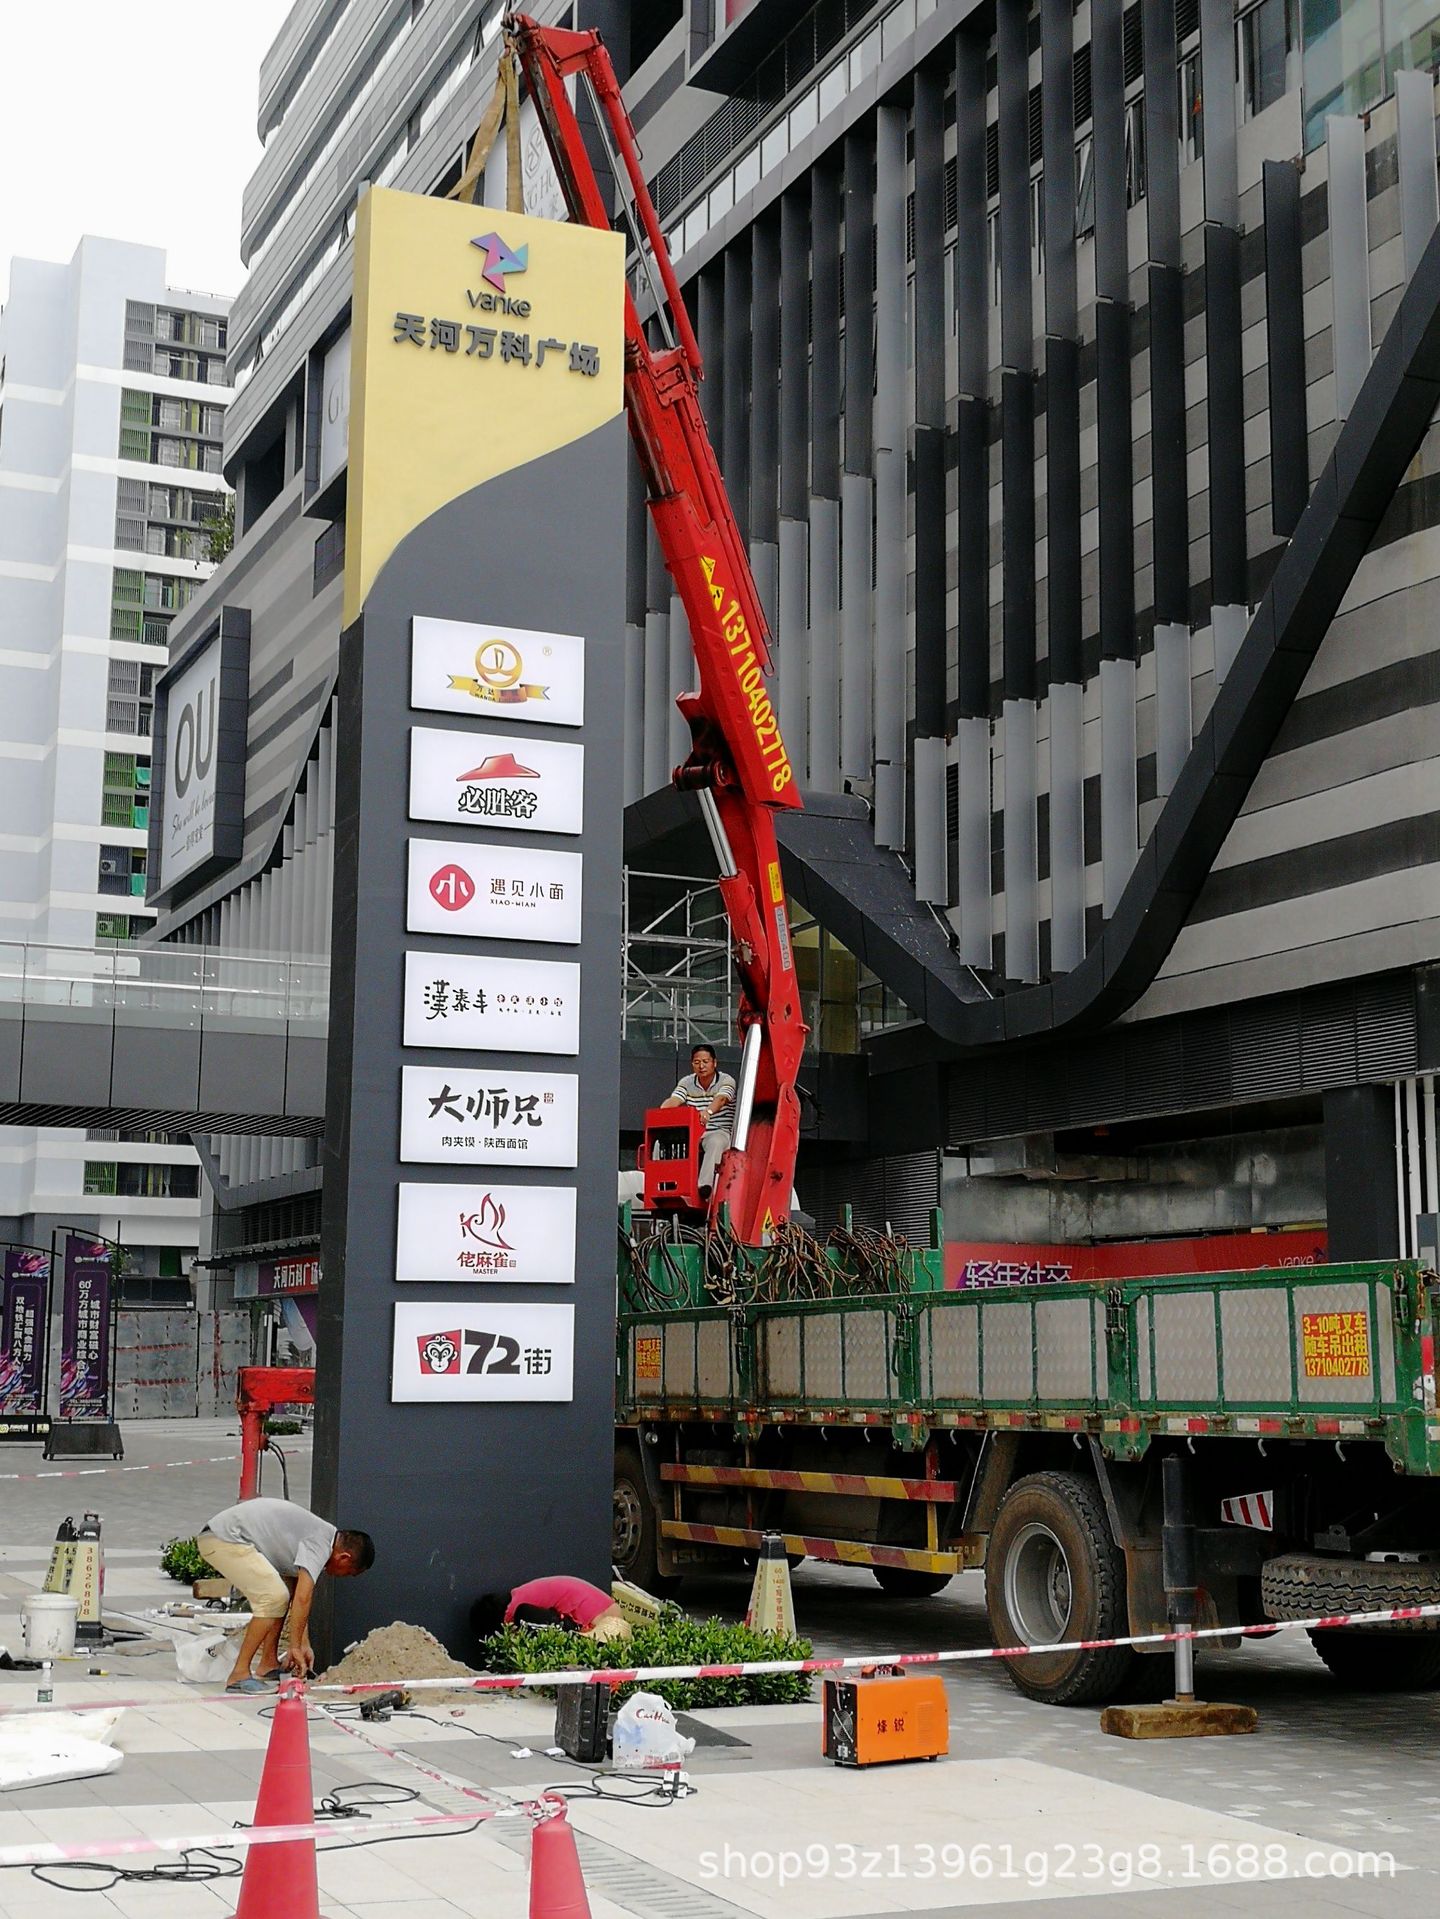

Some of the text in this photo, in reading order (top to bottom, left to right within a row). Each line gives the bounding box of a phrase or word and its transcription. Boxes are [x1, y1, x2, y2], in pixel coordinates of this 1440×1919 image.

[466, 289, 532, 318] vanke
[393, 312, 600, 377] 天河万科广场
[721, 600, 792, 793] 13710402778
[458, 785, 537, 818] 必胜客
[490, 878, 564, 900] 遇见小面
[428, 1084, 543, 1129] 大师兄
[456, 1251, 509, 1268] 佬麻雀
[1303, 1312, 1367, 1335] 3-10吨叉车
[464, 1329, 552, 1375] 72街
[1304, 1334, 1368, 1357] 随车吊出租
[1305, 1357, 1370, 1376] 13710402778
